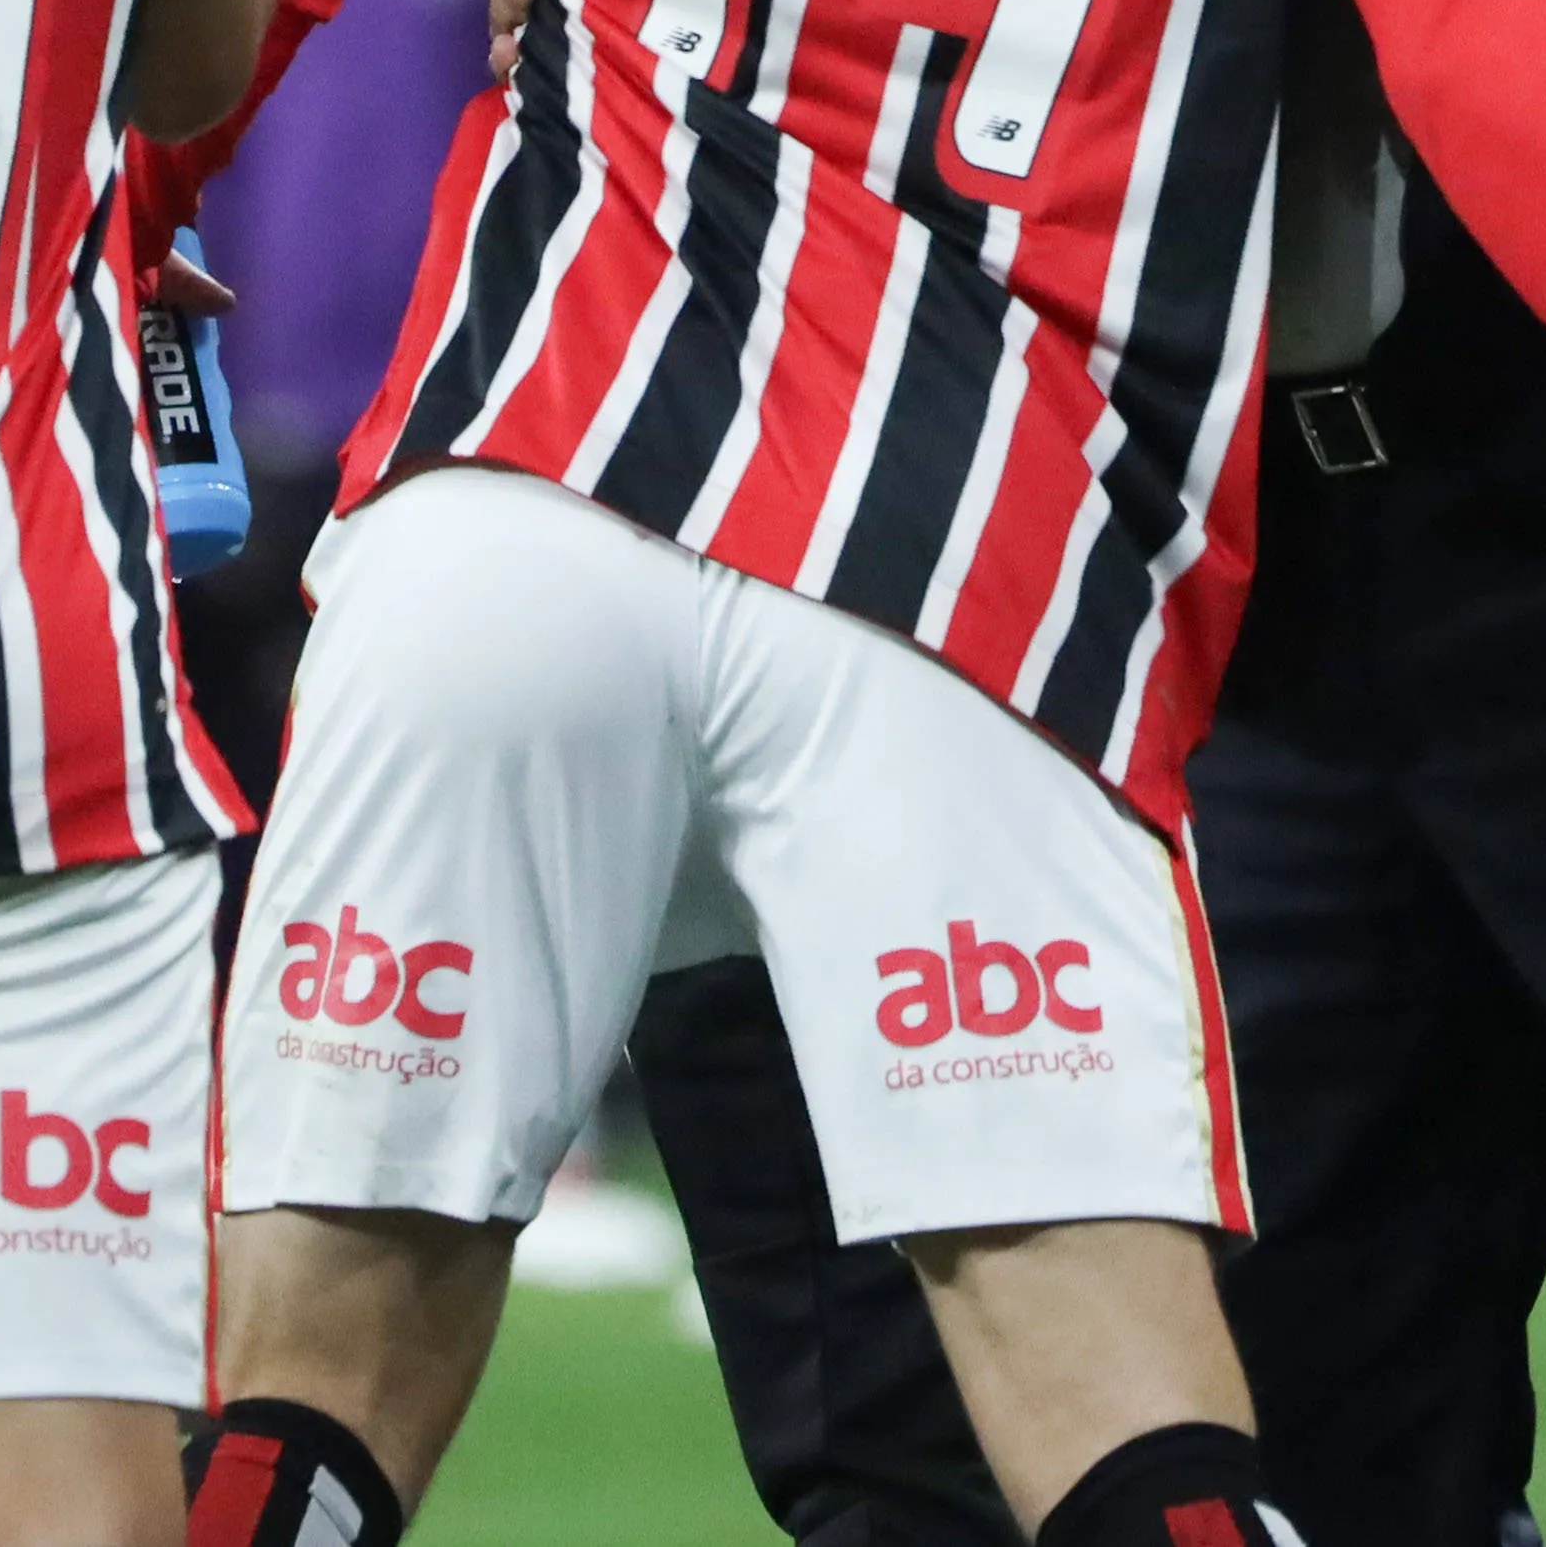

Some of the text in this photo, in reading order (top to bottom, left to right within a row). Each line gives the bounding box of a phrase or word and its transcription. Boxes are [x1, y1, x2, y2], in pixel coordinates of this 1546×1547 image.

[278, 903, 475, 1040] abc
[875, 919, 1104, 1049] abc
[275, 1028, 303, 1059] da
[884, 1041, 1115, 1091] da construção
